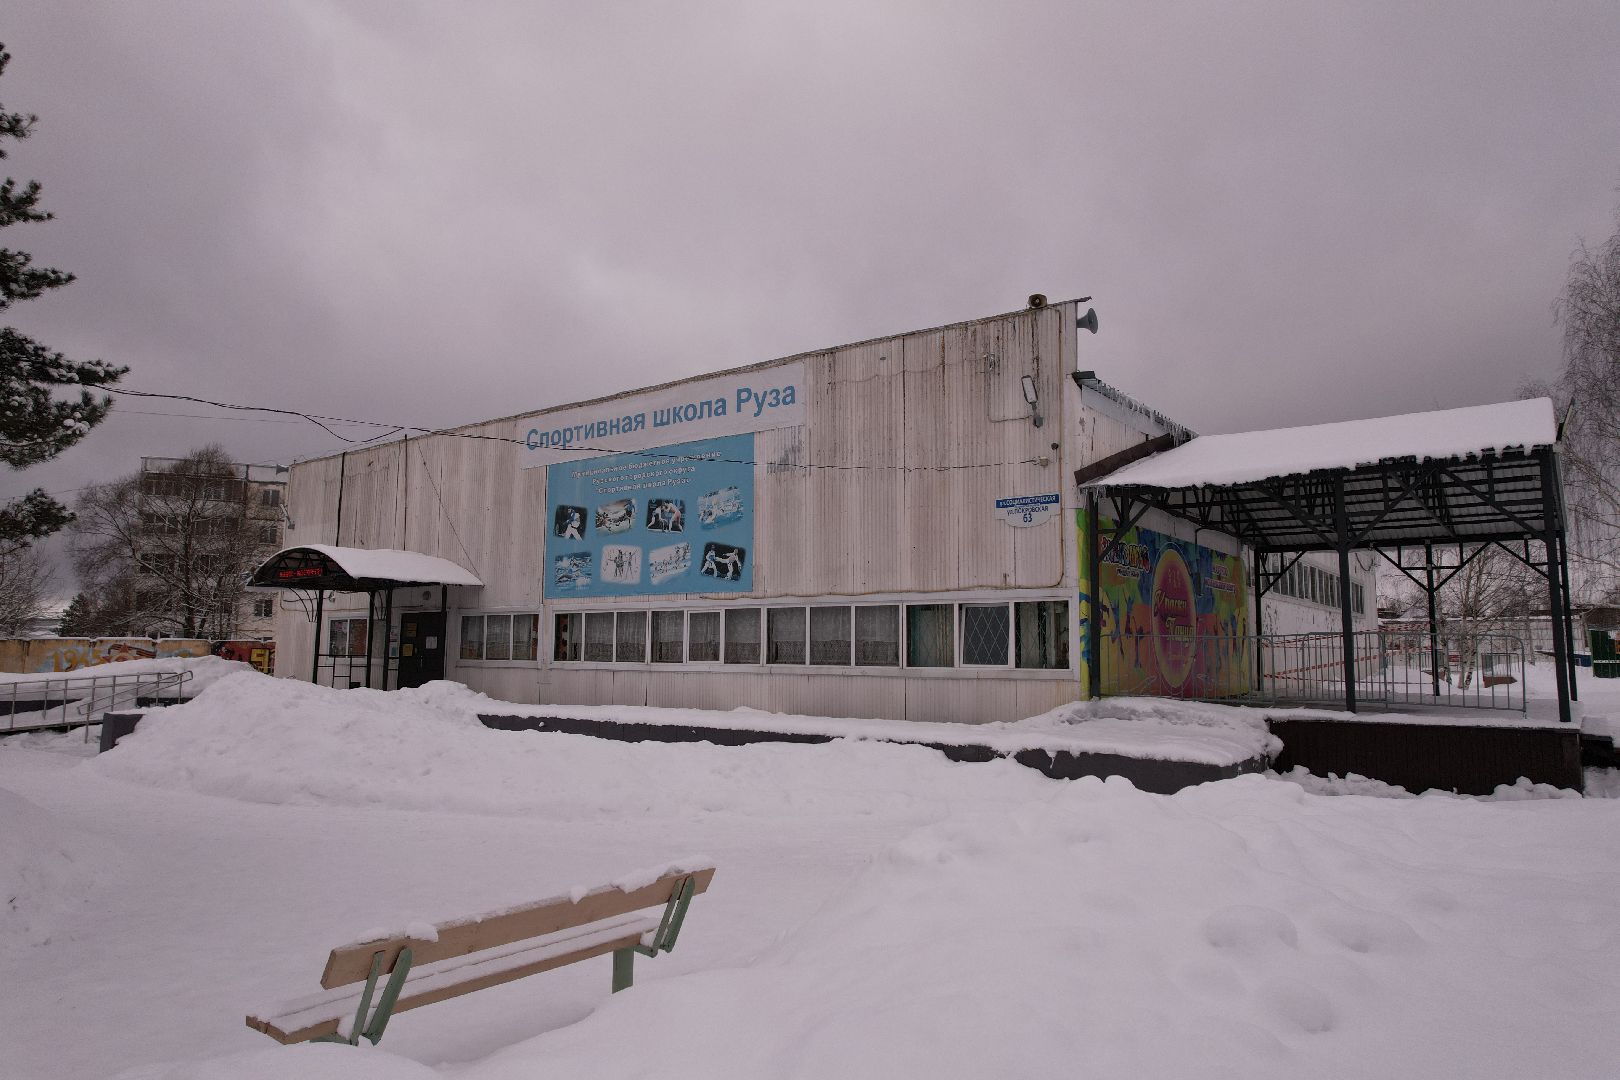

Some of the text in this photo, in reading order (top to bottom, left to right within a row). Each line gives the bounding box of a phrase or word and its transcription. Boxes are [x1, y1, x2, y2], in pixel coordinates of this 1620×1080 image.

[526, 384, 796, 451] Спортивная школа Руза
[1022, 513, 1033, 523] 63
